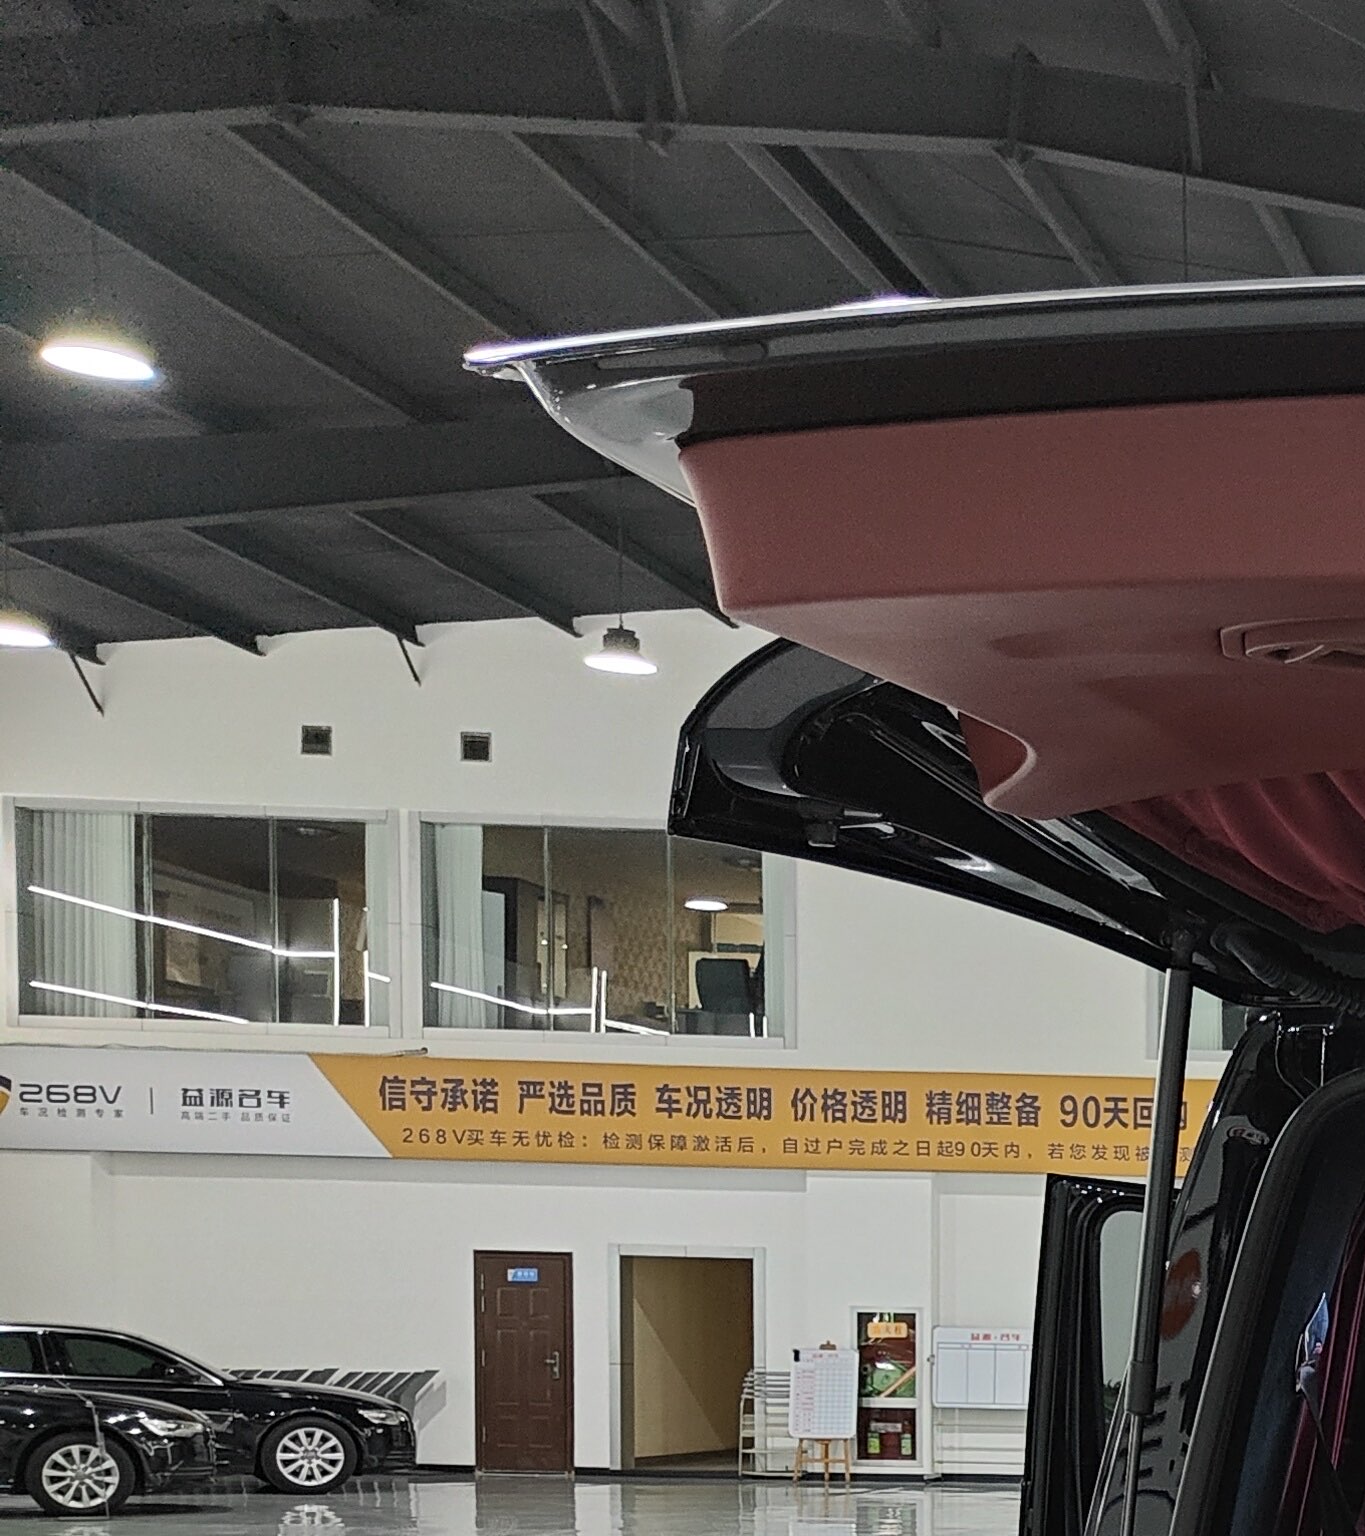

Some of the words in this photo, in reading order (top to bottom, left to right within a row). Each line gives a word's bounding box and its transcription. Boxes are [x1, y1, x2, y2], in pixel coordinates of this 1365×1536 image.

[19, 1083, 123, 1105] 268V
[180, 1086, 291, 1109] 益源名车
[378, 1075, 499, 1115] 信守承诺
[516, 1079, 638, 1118] 严选品质
[654, 1083, 773, 1121] 车况透明
[790, 1087, 908, 1124] 价格透明
[924, 1090, 1042, 1128] 精细整备
[1058, 1093, 1188, 1132] 90天回
